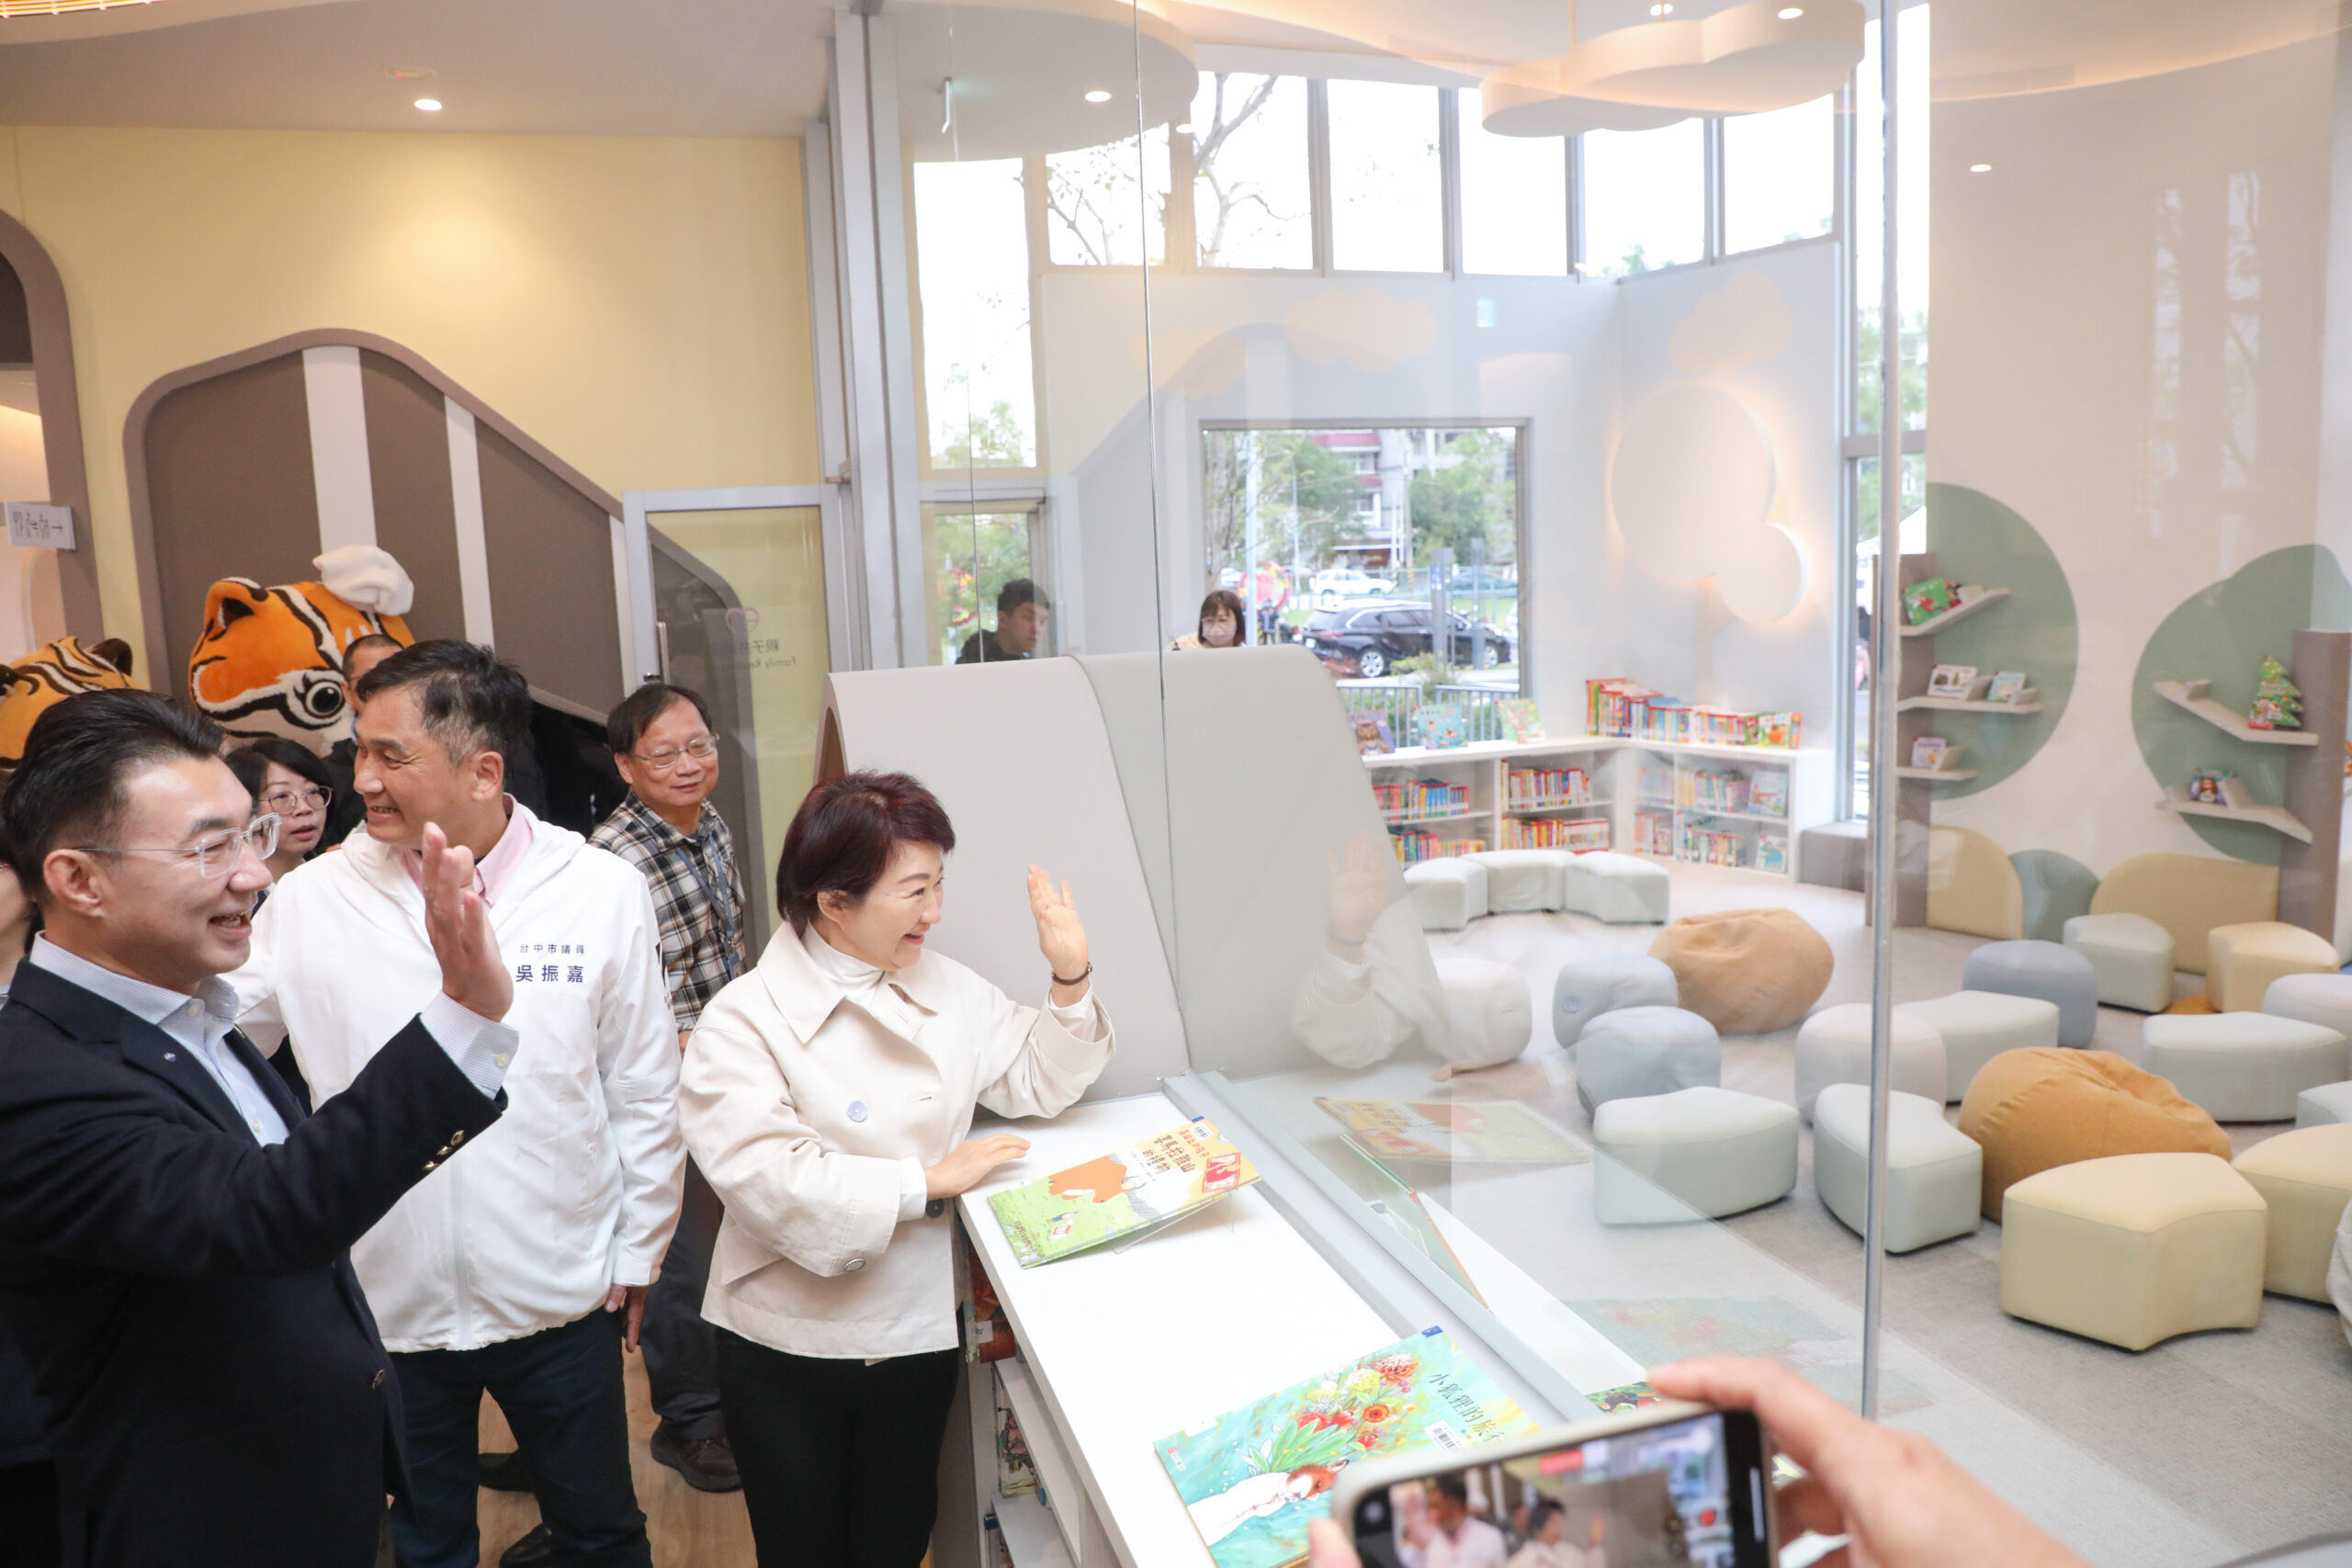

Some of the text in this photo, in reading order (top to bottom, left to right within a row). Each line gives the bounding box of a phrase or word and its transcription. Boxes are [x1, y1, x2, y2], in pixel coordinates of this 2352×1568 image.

[519, 943, 585, 954] 台中市議員
[515, 964, 584, 984] 吳振嘉
[1142, 1149, 1172, 1176] 的禮物
[1153, 1134, 1197, 1173] 喜馬拉雅山
